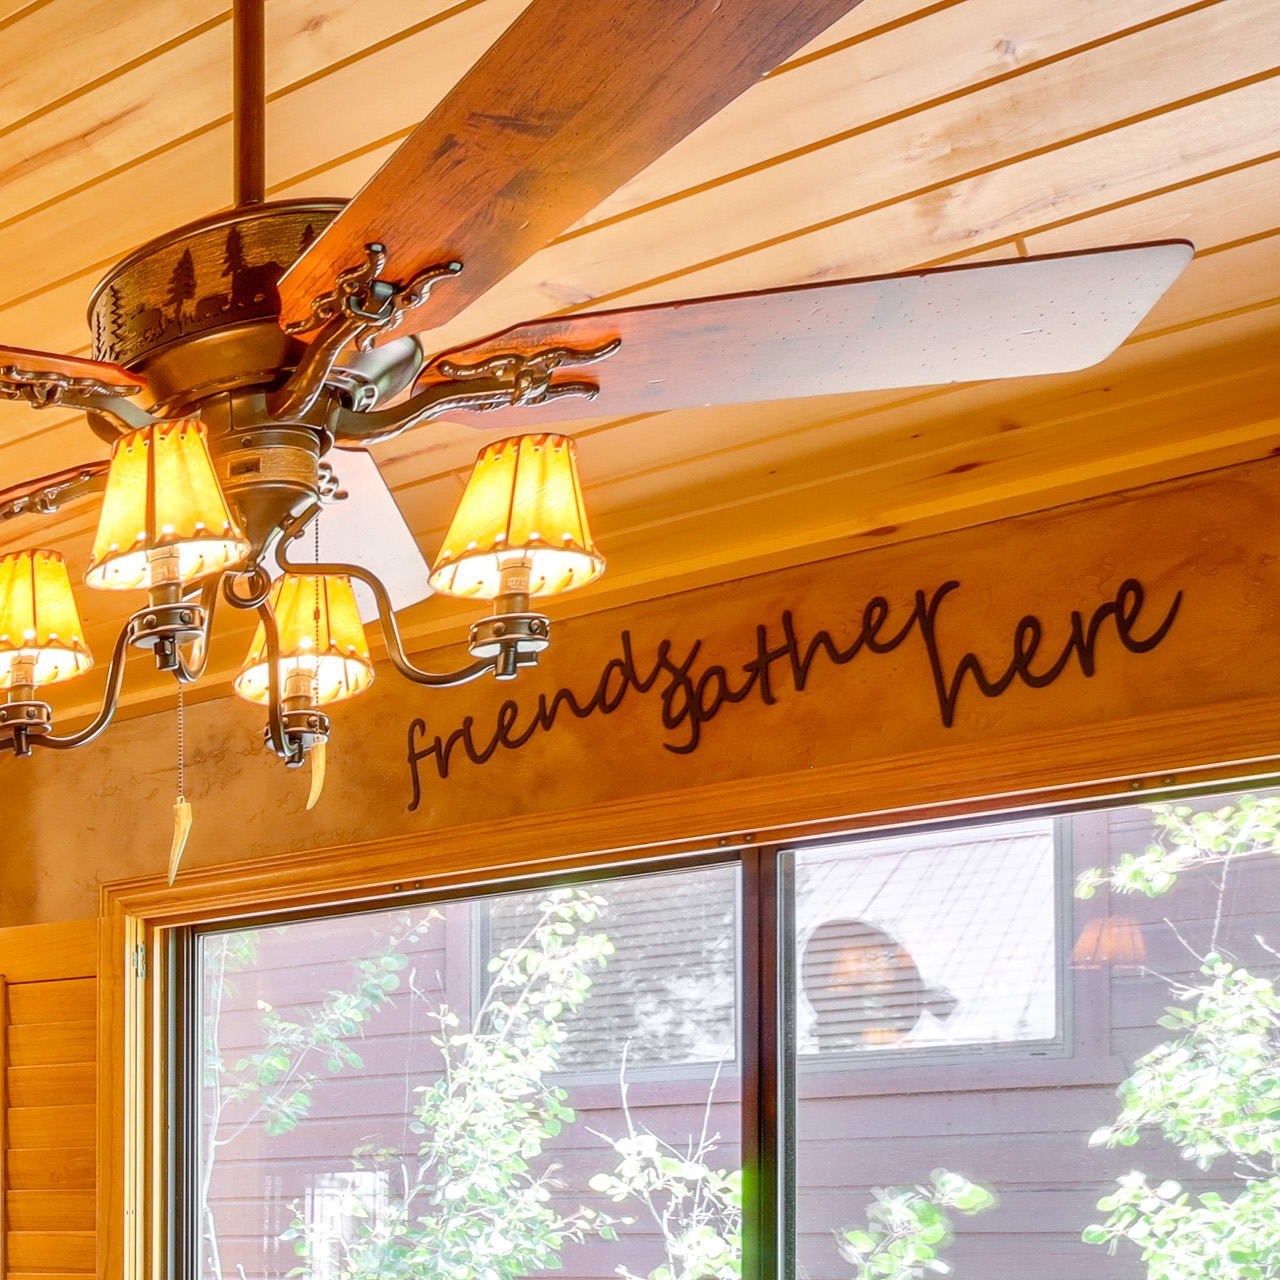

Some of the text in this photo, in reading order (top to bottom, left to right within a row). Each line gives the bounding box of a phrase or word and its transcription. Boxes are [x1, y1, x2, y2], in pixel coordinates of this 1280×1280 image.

[406, 577, 1183, 812] friends gather here
